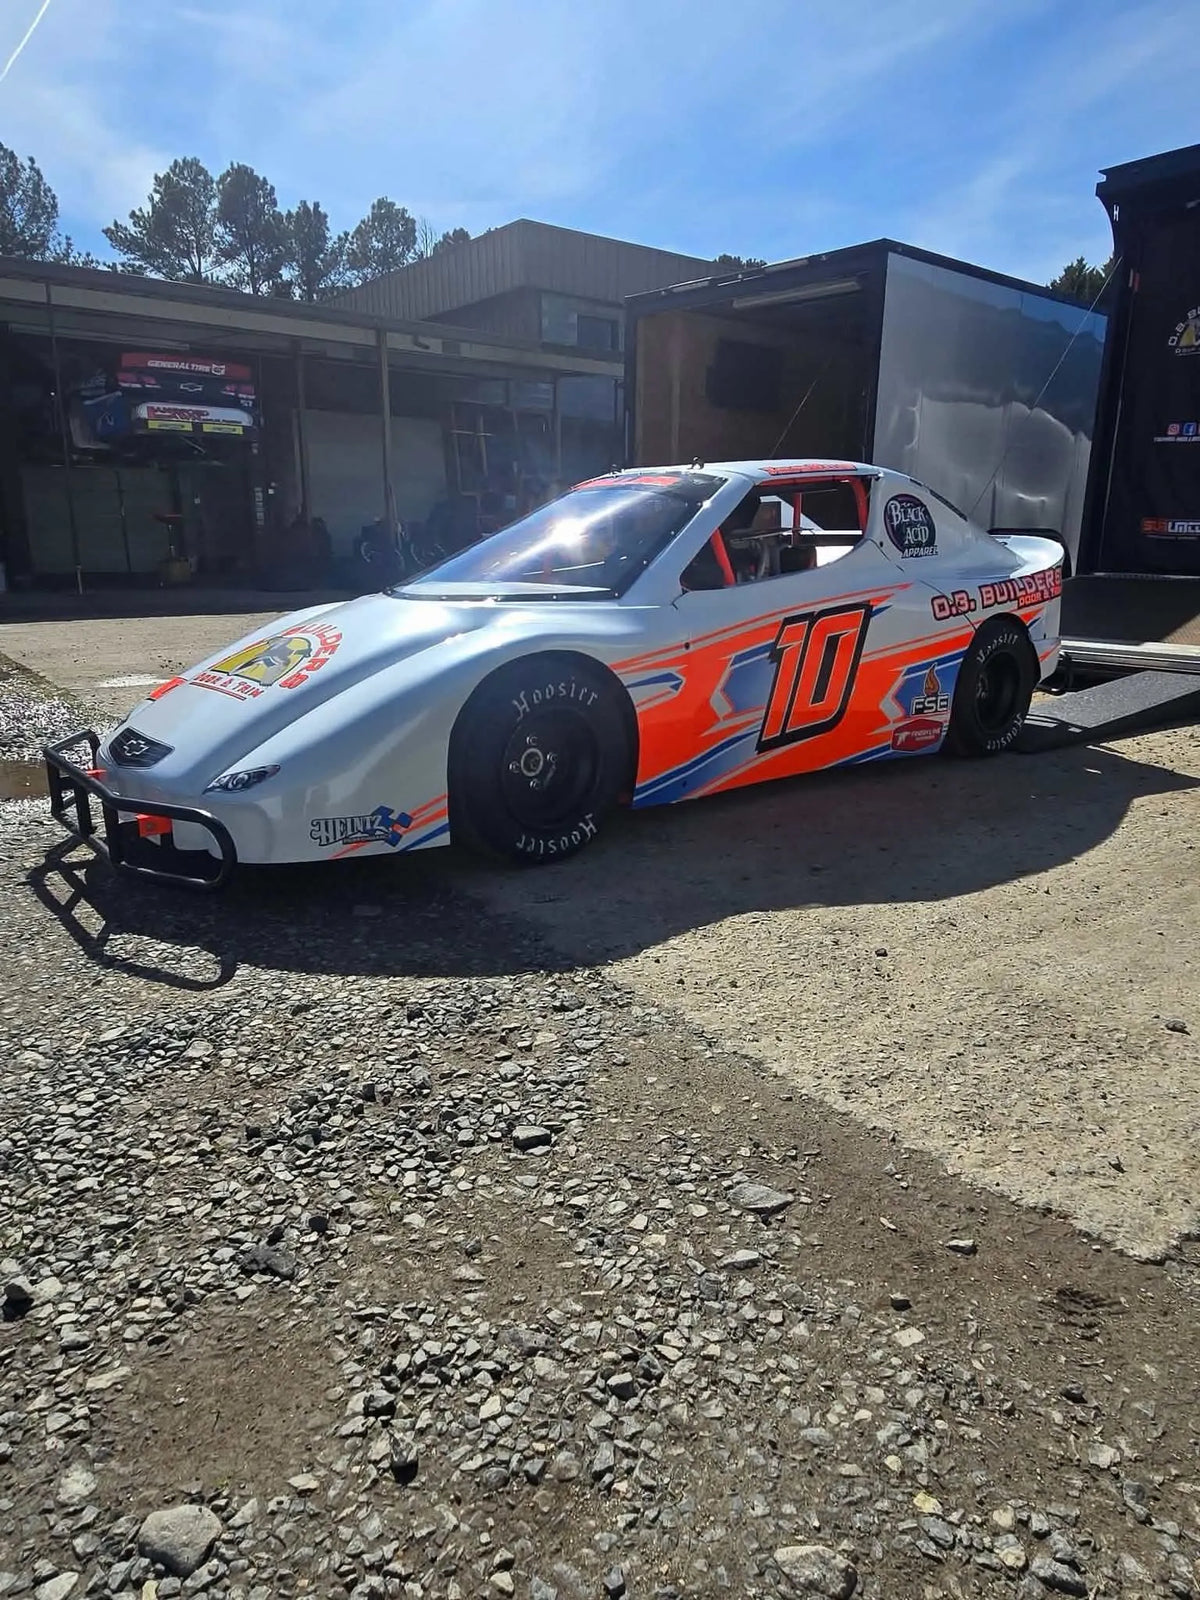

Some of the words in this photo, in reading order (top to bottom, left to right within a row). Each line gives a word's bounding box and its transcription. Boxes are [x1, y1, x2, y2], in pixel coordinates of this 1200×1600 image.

[147, 360, 190, 370] GENERAL
[888, 500, 926, 526] BLACK
[905, 524, 929, 545] ACID
[903, 545, 938, 558] APPAREL
[931, 589, 977, 621] O.B.
[233, 680, 265, 699] TRIM
[755, 600, 873, 754] 10
[512, 676, 599, 722] Hoosier
[911, 694, 950, 715] FSE
[310, 813, 390, 847] HEINTZ
[516, 812, 599, 855] Hoosier
